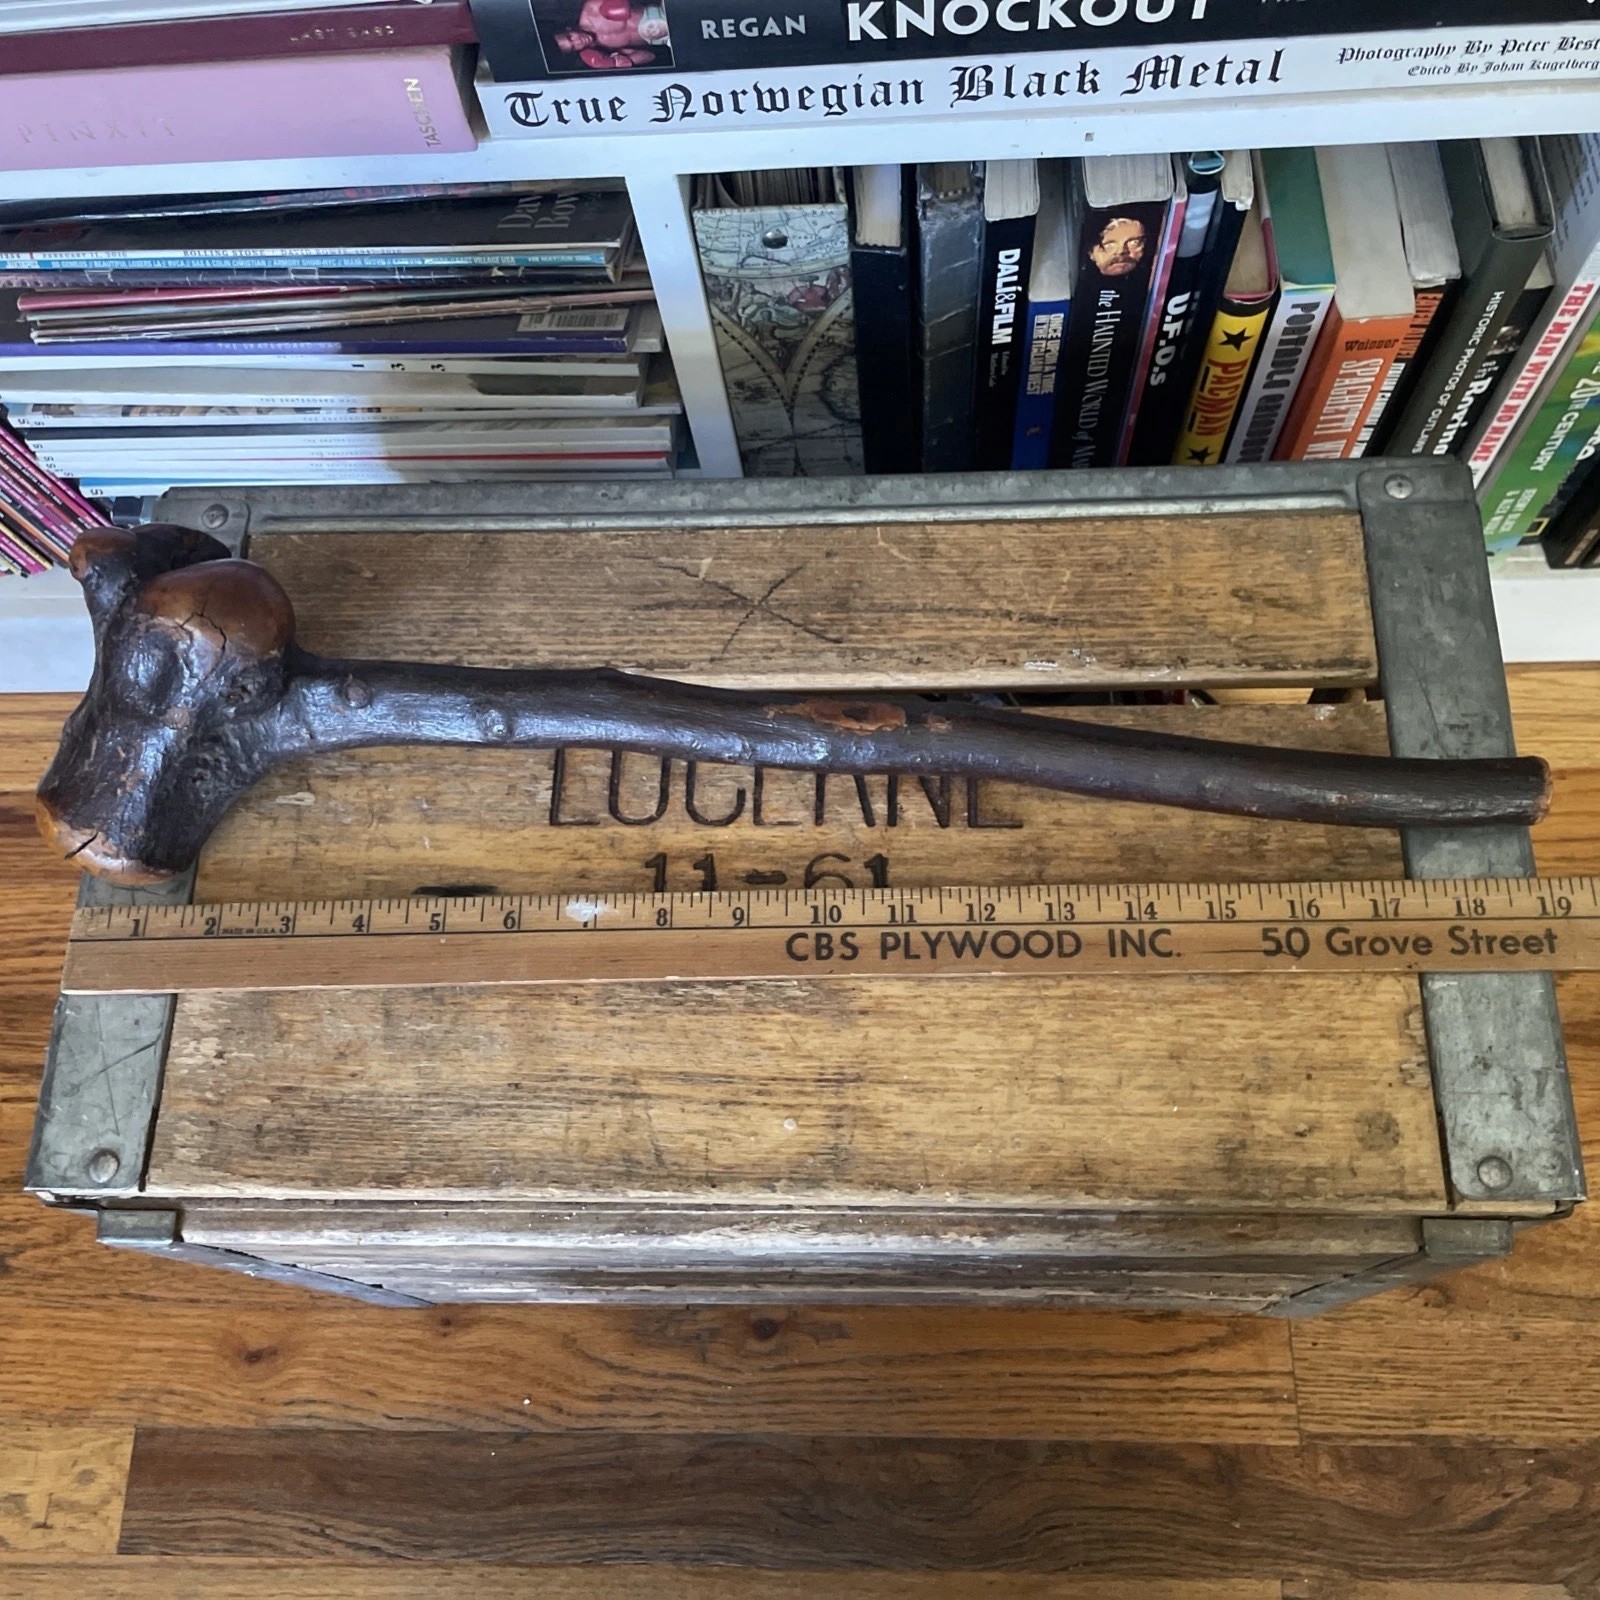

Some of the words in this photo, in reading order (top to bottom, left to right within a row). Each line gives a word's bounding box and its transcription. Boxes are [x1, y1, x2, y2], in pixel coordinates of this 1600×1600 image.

[702, 14, 807, 40] REGAN
[1336, 43, 1457, 64] Photography
[1463, 40, 1493, 57] By
[1499, 37, 1551, 56] Peter
[1554, 35, 1600, 52] Best
[1407, 63, 1451, 77] Edited
[1457, 62, 1479, 75] By
[1484, 60, 1524, 75] Johan
[1528, 57, 1600, 73] Kugelberg
[503, 90, 629, 128] True
[649, 74, 925, 124] Norwegian
[949, 59, 1101, 104] Black
[1119, 48, 1286, 96] Metal
[403, 77, 443, 149] TASCHEN
[183, 249, 228, 257] ROLLING
[232, 248, 265, 256] STONE
[473, 256, 500, 264] VILLAGE
[1098, 289, 1120, 307] the
[1558, 282, 1595, 317] THE
[1047, 312, 1065, 339] ONCE
[1468, 290, 1505, 345] HISTORIC
[1044, 339, 1061, 365] UPON
[1535, 321, 1572, 356] MAN
[1026, 372, 1043, 395] WEST
[1444, 347, 1476, 392] PHOTOS
[1509, 360, 1549, 401] WITH
[1313, 357, 1385, 436] SPAGHETTI
[1437, 393, 1451, 406] OF
[1495, 404, 1521, 423] NO
[1412, 408, 1443, 454] OUTLAWS
[1472, 427, 1511, 462] NAME
[1530, 411, 1580, 471] CENTURY
[129, 918, 140, 938] 1
[204, 917, 217, 936] 2
[279, 915, 291, 934] 3
[352, 914, 366, 933] 4
[428, 913, 441, 932] 5
[502, 911, 516, 930] 6
[656, 908, 668, 927] 8
[731, 906, 745, 926] 9
[810, 905, 843, 924] 10
[887, 904, 918, 924] 11
[966, 903, 997, 922] 12
[1045, 902, 1077, 922] 13
[1124, 901, 1158, 920] 14
[1205, 900, 1237, 920] 15
[1287, 898, 1321, 919] 16
[1370, 898, 1401, 919] 17
[1454, 898, 1487, 918] 18
[1538, 896, 1573, 917] 19
[221, 927, 244, 935] MADE
[245, 927, 254, 935] IN
[785, 931, 860, 962] CBS
[881, 929, 1082, 960] PLYWOOD
[1108, 928, 1182, 958] INC.
[1261, 926, 1311, 957] 50
[1325, 926, 1433, 956] Grove
[1449, 925, 1559, 956] Street
